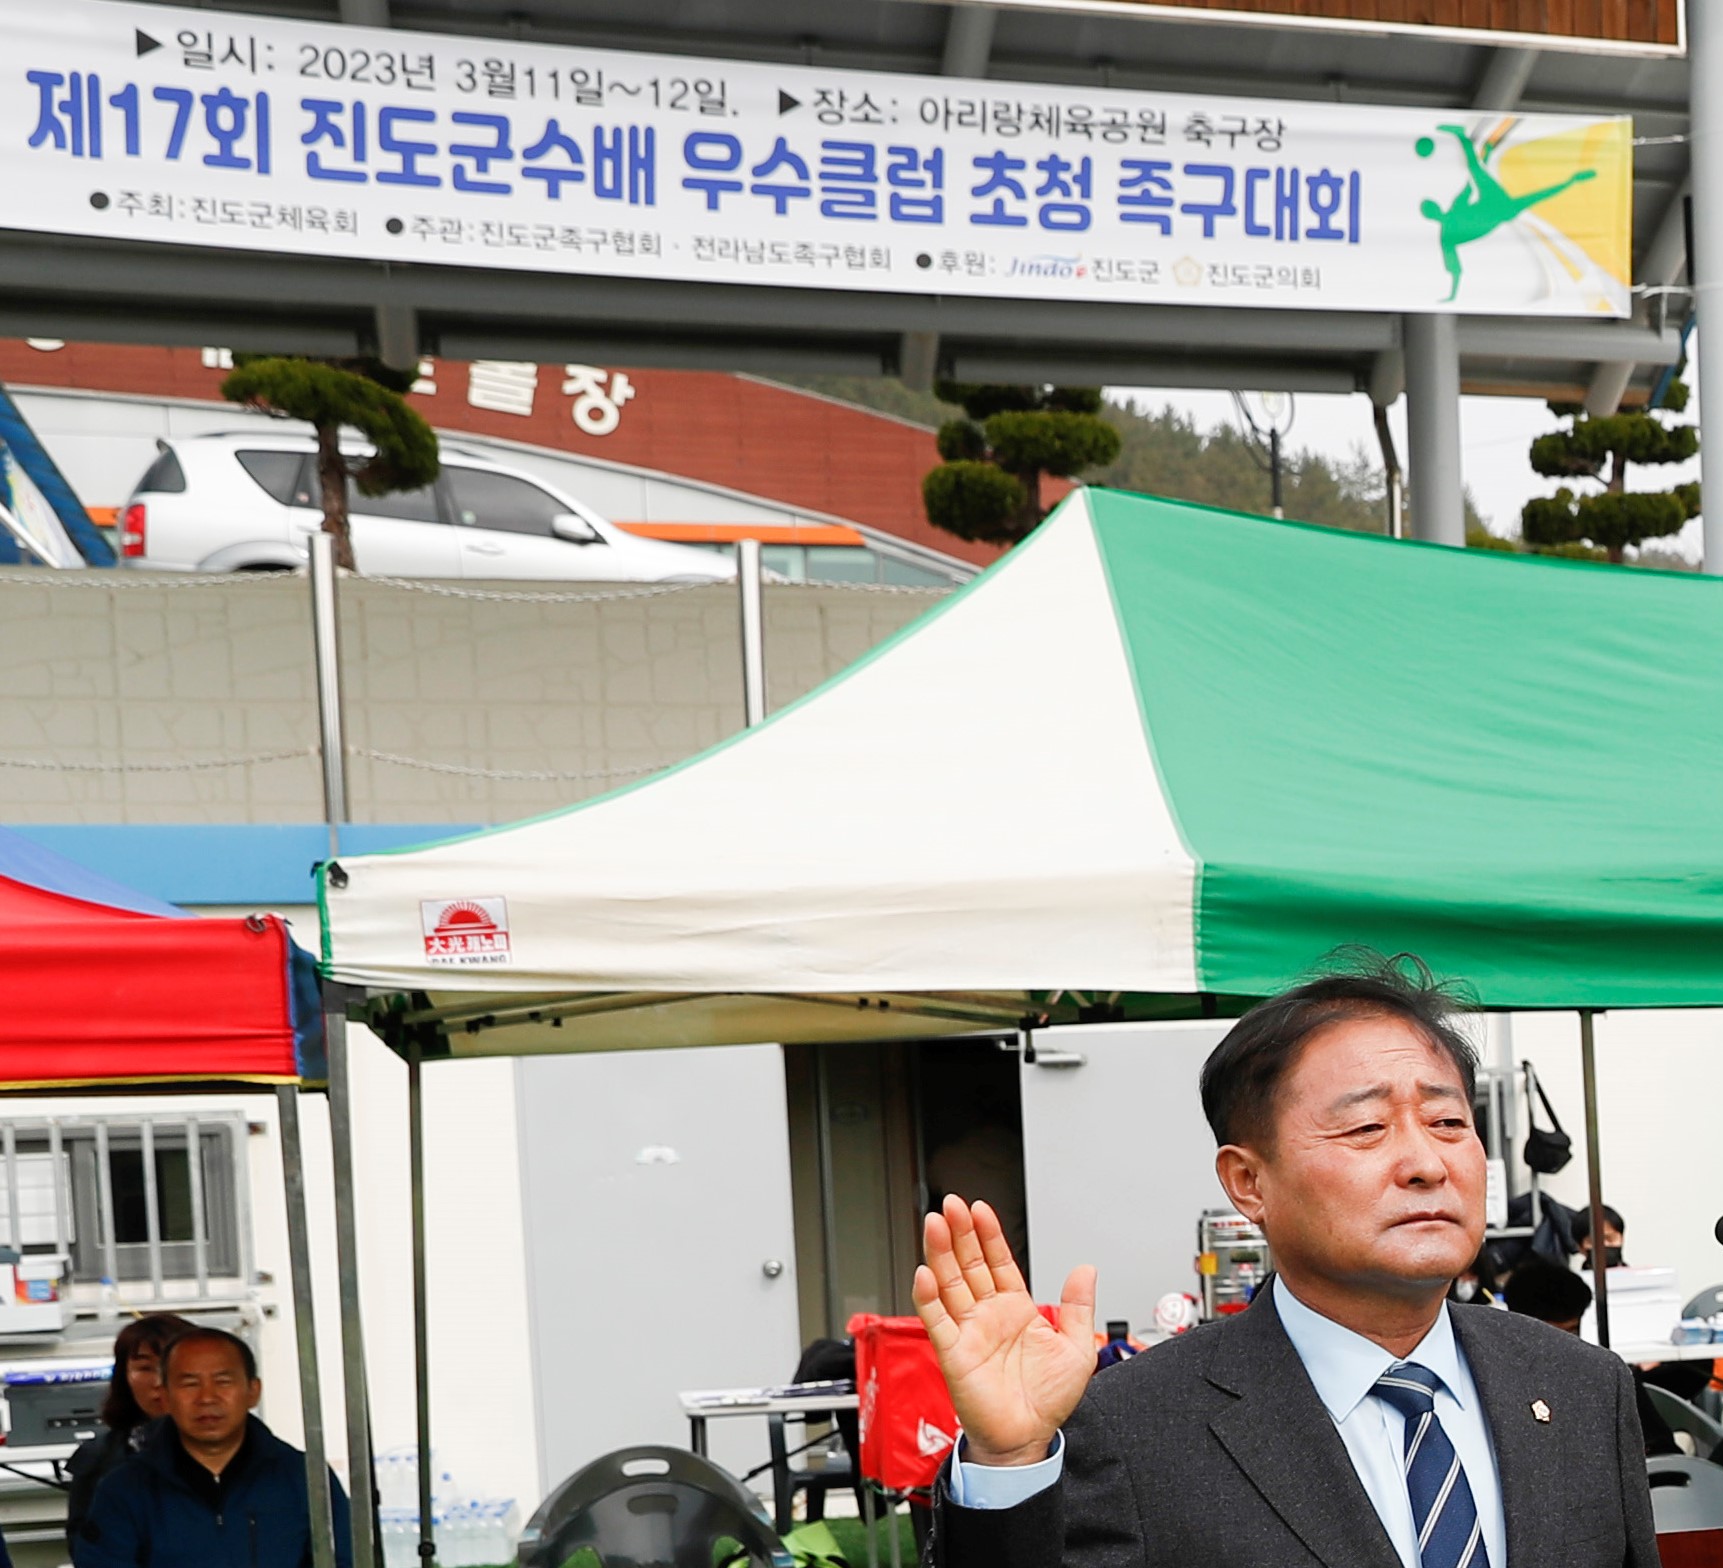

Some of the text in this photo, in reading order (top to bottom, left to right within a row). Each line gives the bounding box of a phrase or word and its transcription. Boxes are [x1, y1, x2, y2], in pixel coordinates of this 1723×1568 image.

[177, 30, 276, 73] 일시:
[299, 44, 436, 91] 2023년
[813, 87, 1287, 151] 장소: 아리랑체육공원 축구장
[26, 69, 1362, 245] 제17회 진도군수배 우수클럽 초청 족구대회
